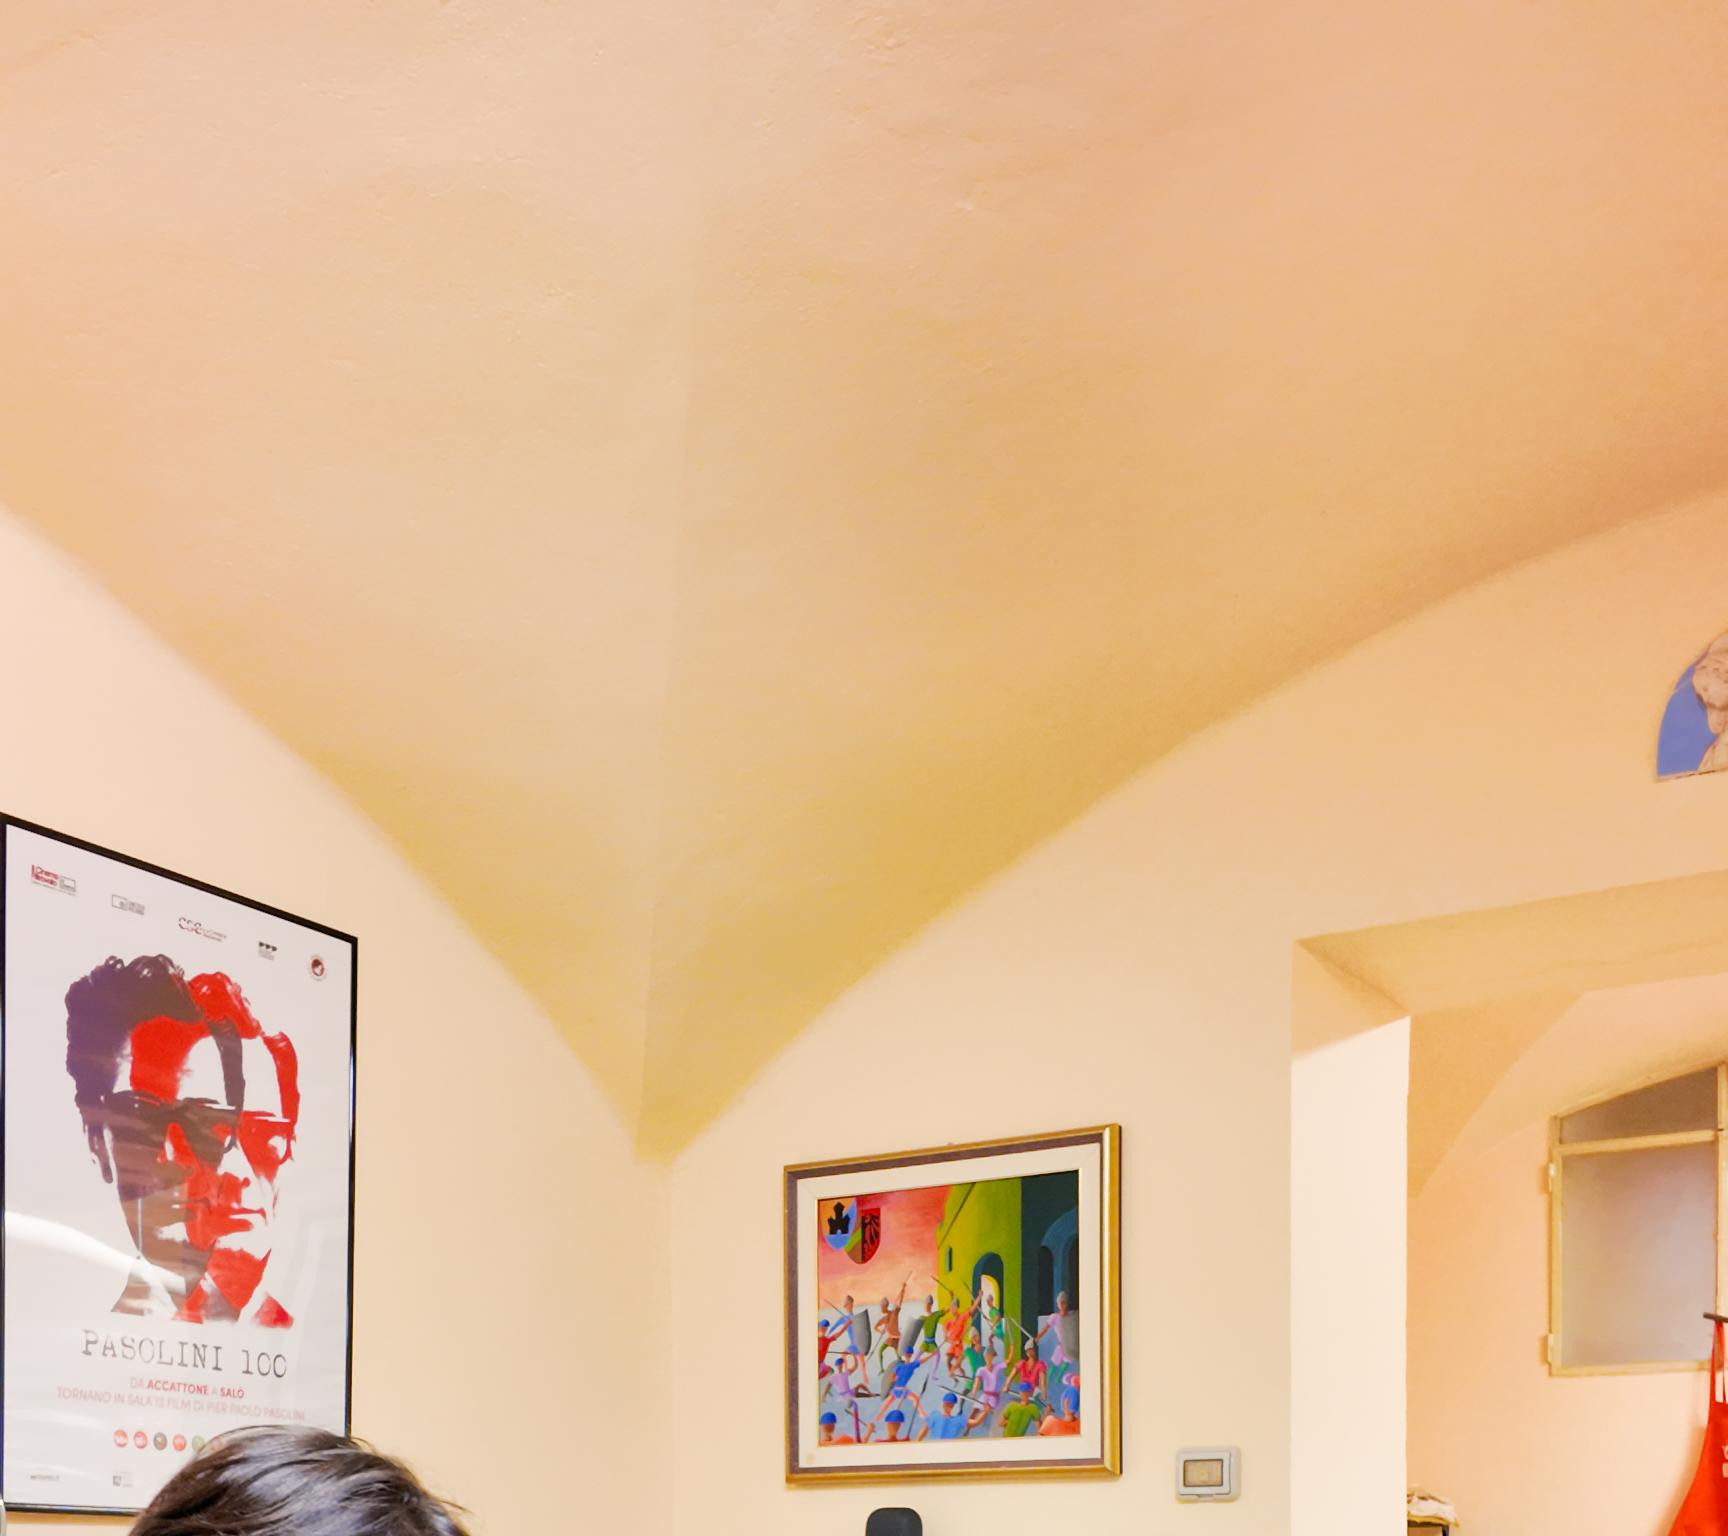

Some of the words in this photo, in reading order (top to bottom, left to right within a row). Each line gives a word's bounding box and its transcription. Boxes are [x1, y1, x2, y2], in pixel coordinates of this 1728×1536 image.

[81, 1329, 223, 1371] PASOLINI
[242, 1349, 287, 1378] 100
[56, 1386, 112, 1403] TORNANO
[114, 1391, 125, 1404] IN
[129, 1376, 144, 1389] DA
[146, 1379, 208, 1396] ACCATTONE
